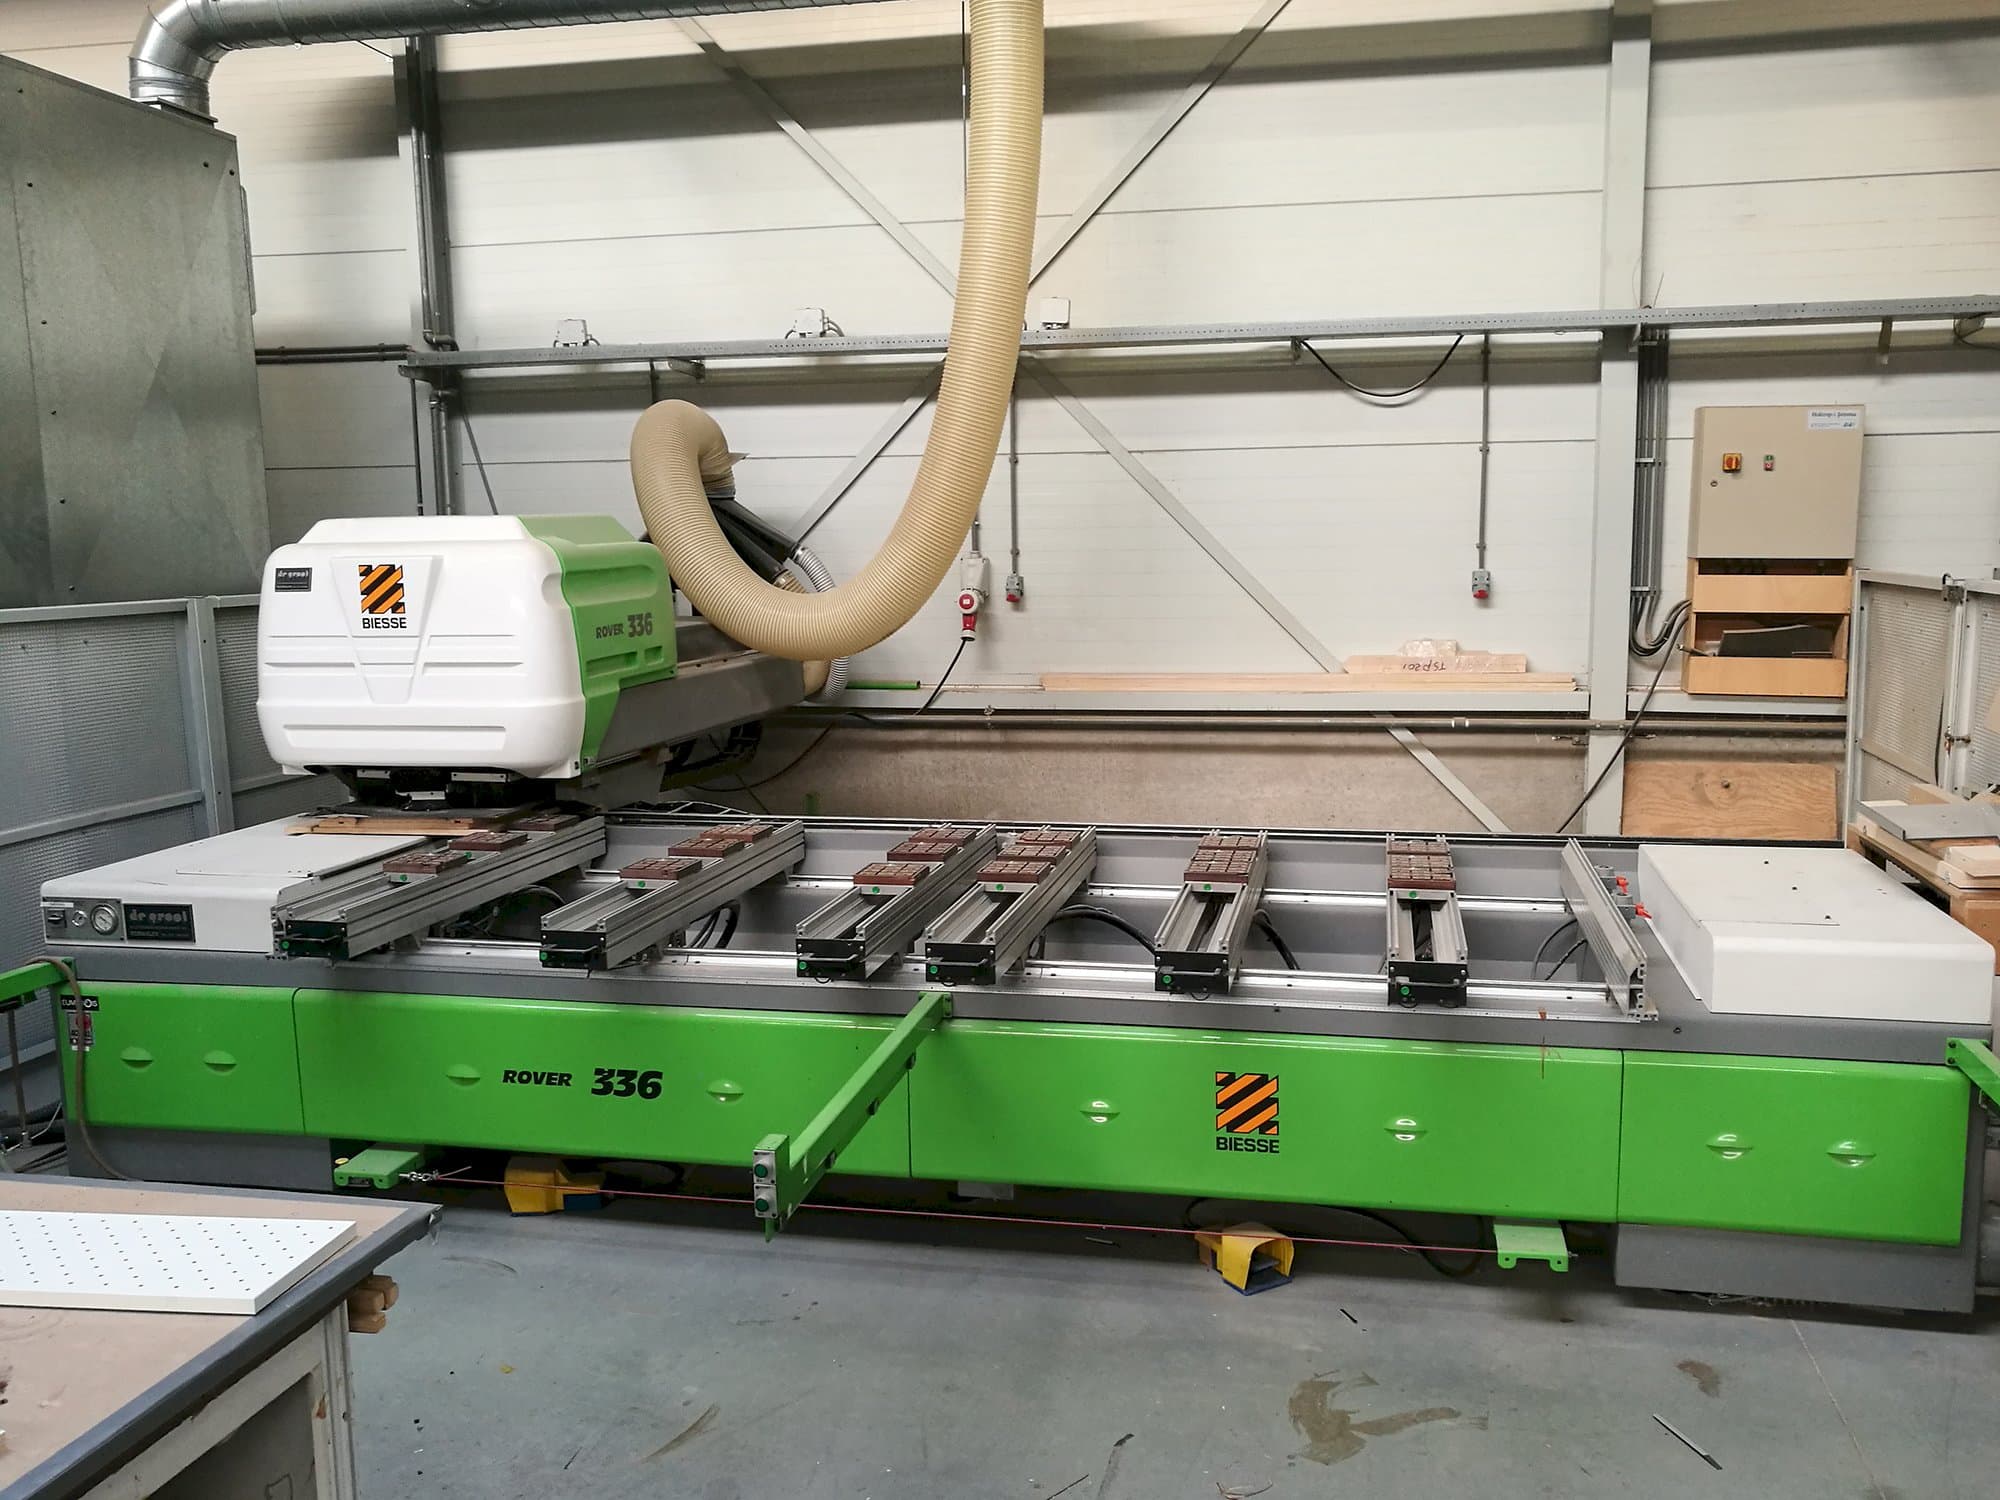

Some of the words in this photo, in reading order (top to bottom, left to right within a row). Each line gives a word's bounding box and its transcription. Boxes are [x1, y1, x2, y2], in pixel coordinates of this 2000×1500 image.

[362, 617, 407, 629] BIESSE
[596, 623, 624, 639] ROVER
[627, 612, 653, 638] 336
[503, 1069, 572, 1087] ROVER
[591, 1067, 664, 1100] 336
[1216, 1136, 1280, 1154] BIESSE
